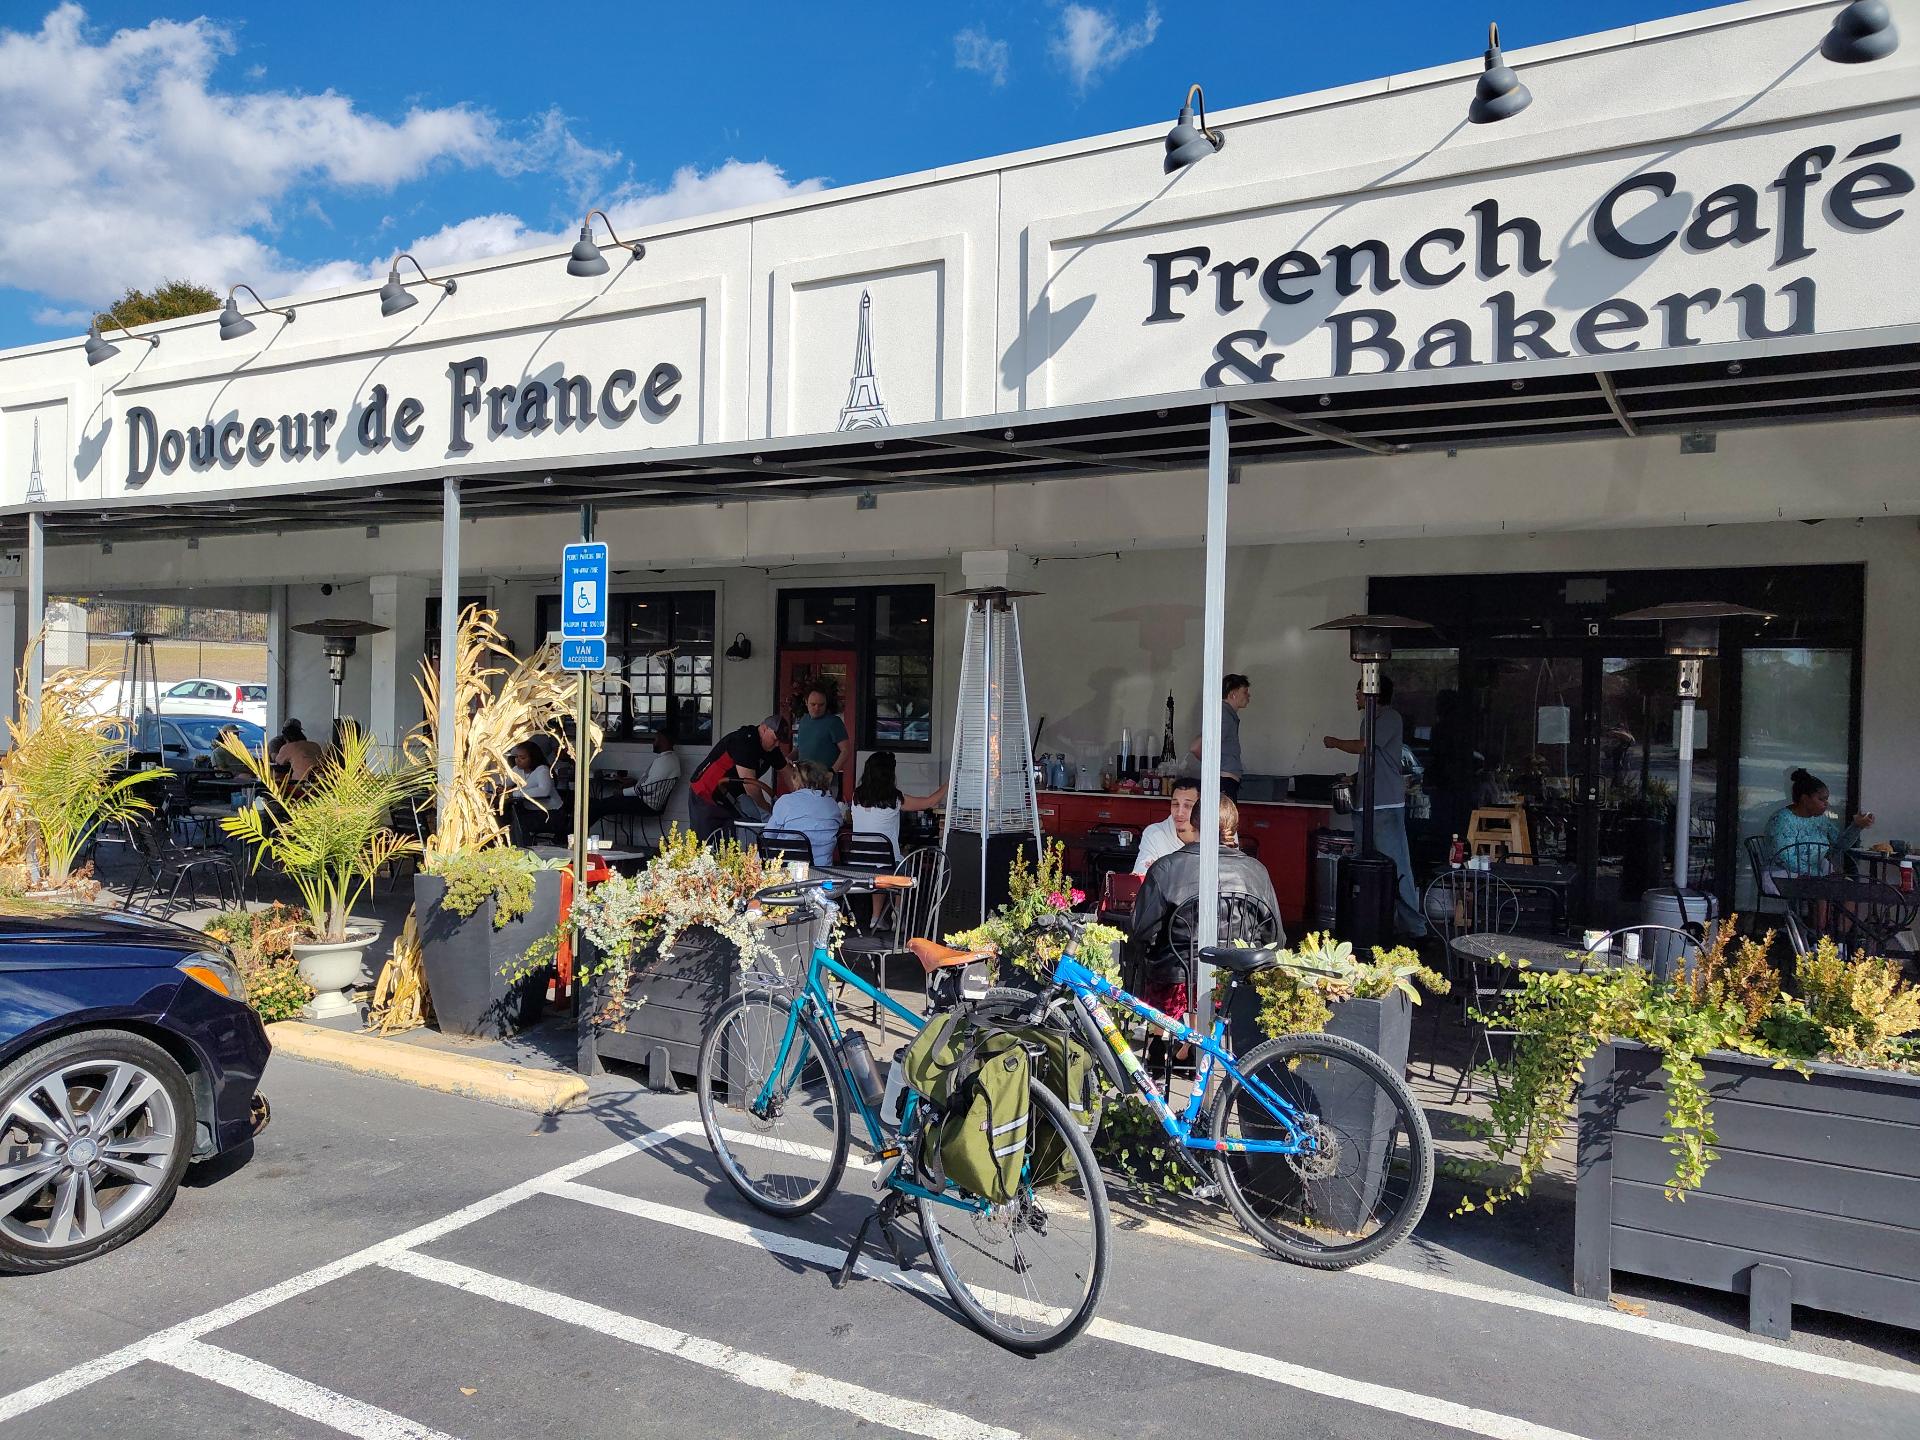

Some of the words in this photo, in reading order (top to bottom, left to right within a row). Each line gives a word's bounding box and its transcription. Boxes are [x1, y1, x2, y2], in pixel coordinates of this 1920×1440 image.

[1142, 197, 1553, 325] French
[1592, 134, 1916, 267] Café
[1204, 328, 1286, 389] &
[124, 405, 338, 487] Douceur
[357, 383, 426, 449] de
[444, 355, 683, 452] France
[575, 645, 592, 655] VAN
[1589, 624, 1598, 635] C
